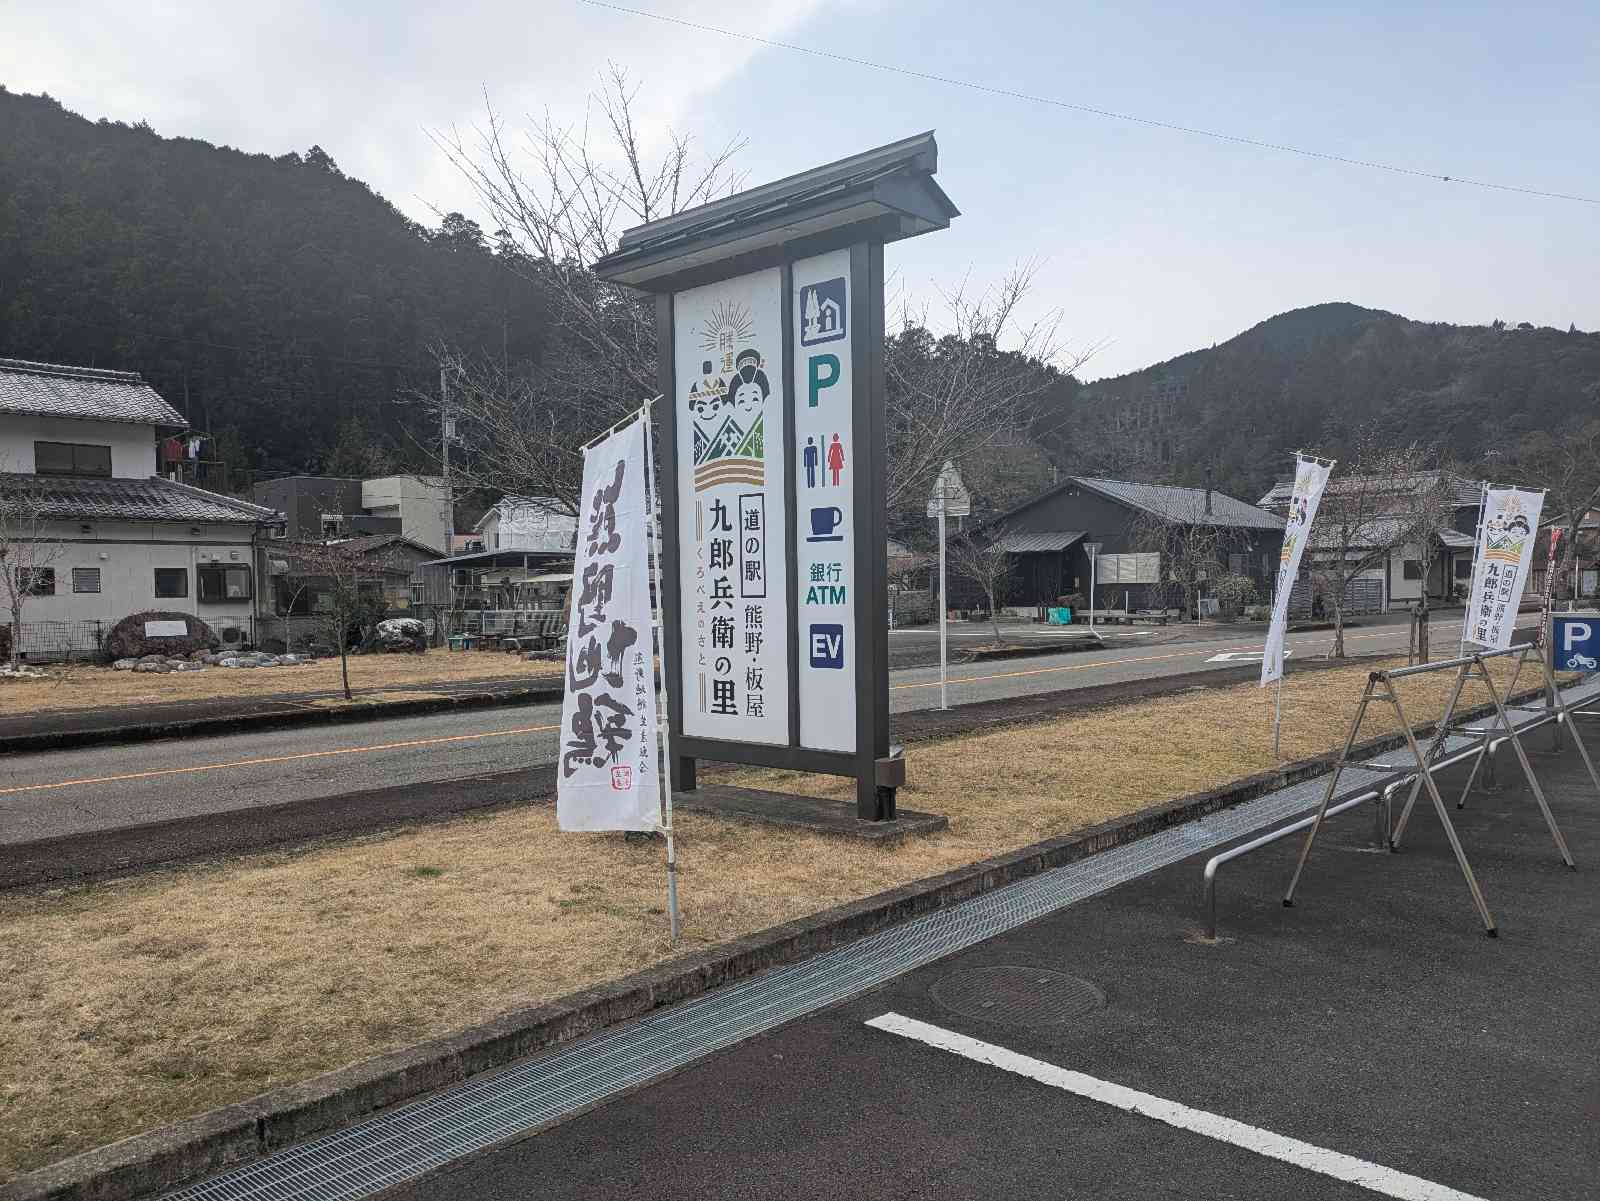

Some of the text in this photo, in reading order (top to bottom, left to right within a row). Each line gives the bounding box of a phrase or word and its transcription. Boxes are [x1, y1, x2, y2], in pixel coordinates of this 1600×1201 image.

[808, 353, 841, 408] P
[744, 509, 762, 582] 道の駅
[809, 562, 843, 583] 銀行
[696, 547, 707, 667] くろべえのさと
[709, 498, 739, 716] 九郎兵衛の里
[805, 585, 847, 605] ATM
[744, 604, 764, 718] 熊野・板屋
[811, 633, 842, 660] EV
[1562, 622, 1592, 651] P
